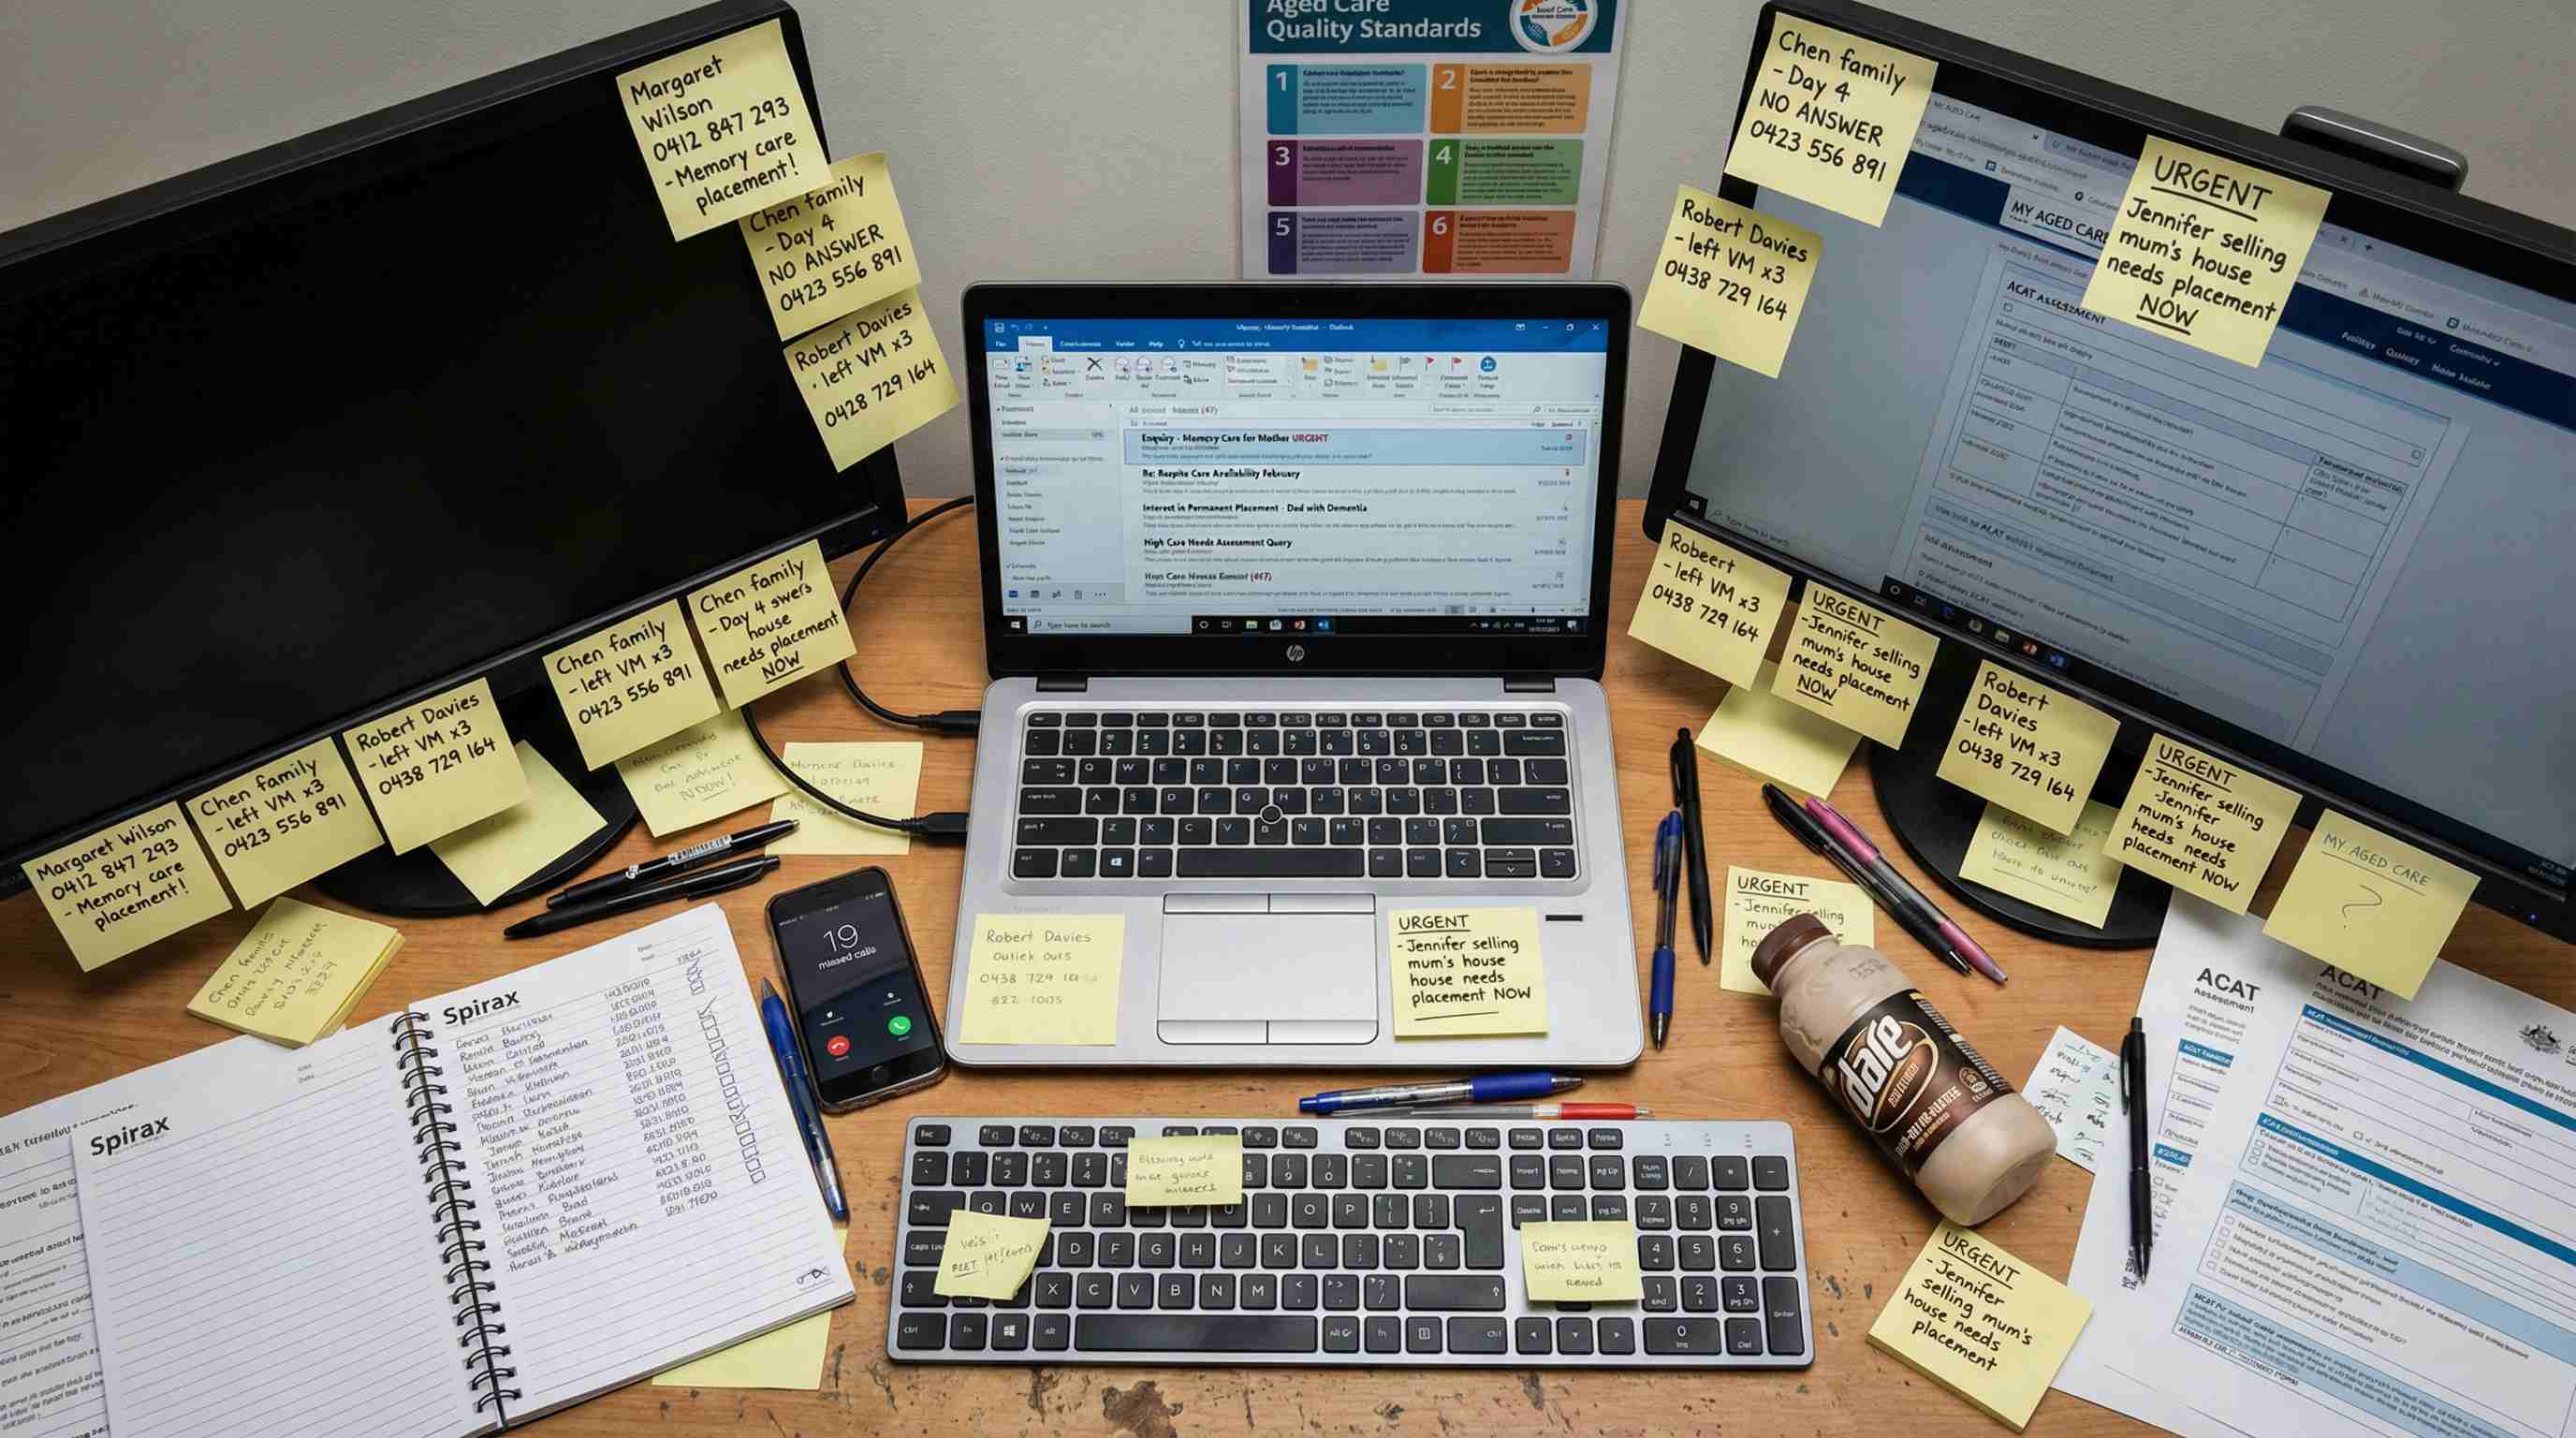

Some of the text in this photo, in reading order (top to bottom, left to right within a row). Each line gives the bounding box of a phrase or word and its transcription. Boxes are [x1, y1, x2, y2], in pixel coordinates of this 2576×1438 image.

[1267, 18, 1482, 43] Quality Standards
[630, 55, 724, 105] Margaret
[1441, 70, 1456, 90] 2
[1778, 30, 1907, 95] Chen family
[1276, 72, 1287, 92] 1
[1787, 64, 1850, 102] Day 4
[643, 95, 713, 132] Wilson
[653, 97, 790, 162] 0412 847 293
[1760, 89, 1883, 147] NO ANSWER
[755, 131, 798, 158] care
[1275, 146, 1290, 167] 3
[1435, 145, 1452, 165] 4
[1751, 120, 1886, 182] 0423 556 891
[696, 157, 799, 214] placement!
[750, 174, 864, 232] Chen family
[2154, 155, 2273, 213] URGENT
[777, 213, 835, 251] Day 4
[1276, 217, 1290, 237] 5
[1432, 215, 1448, 236] 6
[1682, 199, 1808, 263] Robert Davies
[2012, 200, 2034, 217] MY
[2035, 211, 2073, 230] AGED
[2126, 197, 2288, 272] Jennifer selling
[769, 225, 884, 286] NO ANSWER
[1689, 232, 1785, 283] left VM x3
[2118, 227, 2253, 287] mum's house
[781, 245, 902, 311] 0423 556 891
[1665, 259, 1788, 321] 0438 729 164
[2007, 281, 2037, 299] ACAT
[2107, 256, 2277, 323] needs placement
[2140, 294, 2200, 330] NOW
[1258, 434, 1290, 443] Mother
[1293, 434, 1328, 443] URGENT
[1188, 504, 1233, 512] Permanent
[1236, 504, 1279, 512] Placement
[1307, 503, 1325, 511] with
[1327, 504, 1368, 512] Dementia
[1144, 539, 1164, 549] High
[1266, 538, 1293, 549] Query
[699, 559, 805, 614] Chen family
[719, 611, 749, 632] Day
[755, 600, 765, 614] 4
[747, 614, 792, 640] house
[1813, 589, 1886, 632] URGENT
[723, 611, 840, 675] needs placement
[1801, 634, 1893, 683] mum's house
[1872, 644, 1921, 679] selling
[762, 651, 802, 679] NOW
[1793, 651, 1910, 712] needs placement
[1796, 674, 1837, 701] NOW
[2159, 743, 2238, 786] URGENT
[2138, 801, 2237, 855] mum's house
[2217, 796, 2264, 831] selling
[36, 815, 177, 881] Margaret Wilson
[2123, 836, 2197, 882] placement
[2203, 868, 2241, 893] NOW
[2185, 842, 2228, 869] needs
[2323, 829, 2431, 888] MY AGED CARE
[51, 838, 180, 901] 0412 847 293
[77, 860, 185, 917] Memory care
[1738, 876, 1809, 896] URGENT
[95, 879, 190, 932] placement!
[1398, 913, 1471, 932] URGENT
[823, 923, 859, 952] 19
[987, 929, 1091, 943] Robert Davies
[1472, 936, 1519, 955] selling
[818, 946, 877, 970] missed calls
[1407, 952, 1506, 970] mum's house
[1410, 971, 1506, 988] house needs
[1412, 987, 1531, 1007] placement NOW
[2197, 968, 2261, 1001] ACAT
[2320, 964, 2384, 1001] ACAT
[442, 989, 520, 1026] Spirax
[1838, 1015, 1913, 1118] dare
[90, 1116, 171, 1157] Spirax
[1940, 1229, 2021, 1284] URGENT
[1903, 1287, 2002, 1354] house needs
[1920, 1275, 2036, 1347] selling mum's
[1910, 1321, 1998, 1372] placement
